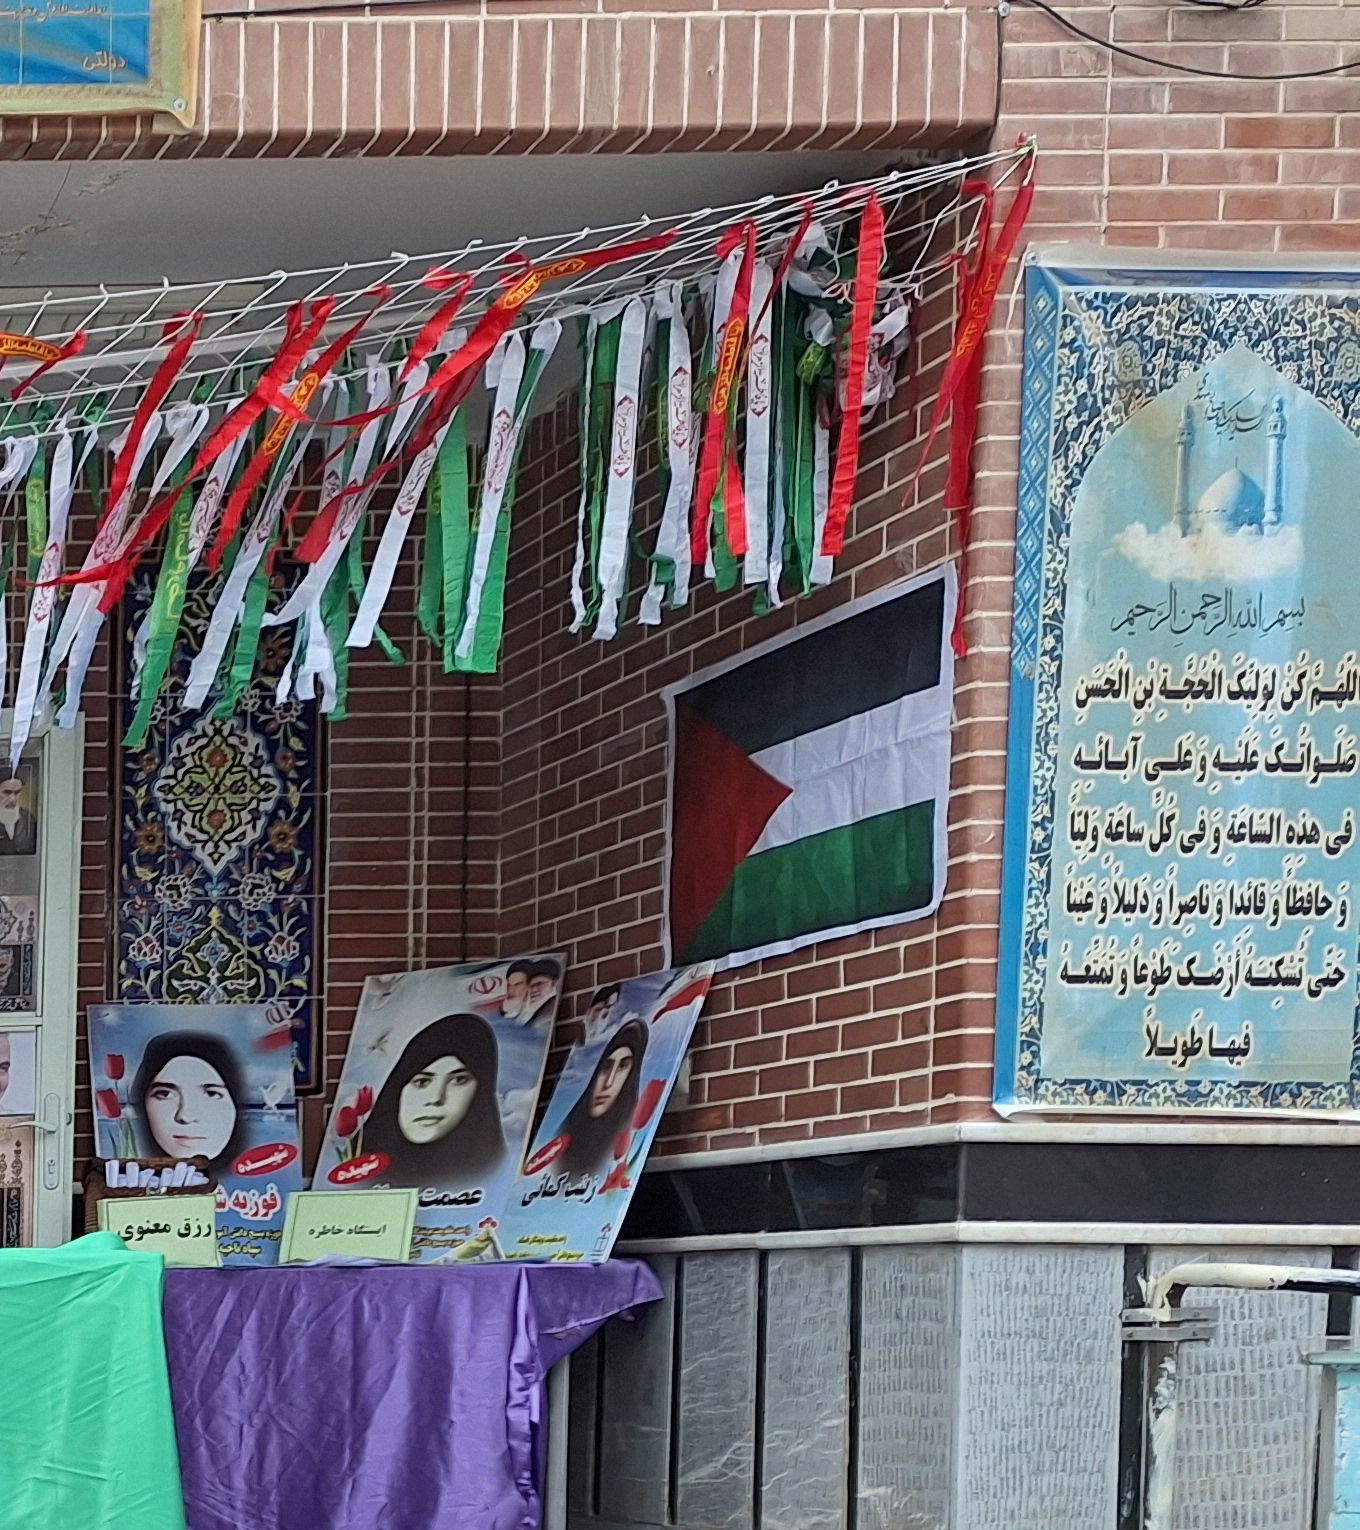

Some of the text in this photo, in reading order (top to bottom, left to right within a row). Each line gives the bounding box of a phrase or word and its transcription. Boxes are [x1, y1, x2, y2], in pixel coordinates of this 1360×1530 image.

[82, 51, 126, 72] دولتی
[237, 1145, 289, 1173] شهیده
[337, 1153, 379, 1180] شهیده
[233, 1186, 277, 1217] فوزیه
[565, 1172, 599, 1204] زینب
[117, 1218, 212, 1242] رزق معنوی
[308, 1224, 387, 1239] ایستگاه خاطره
